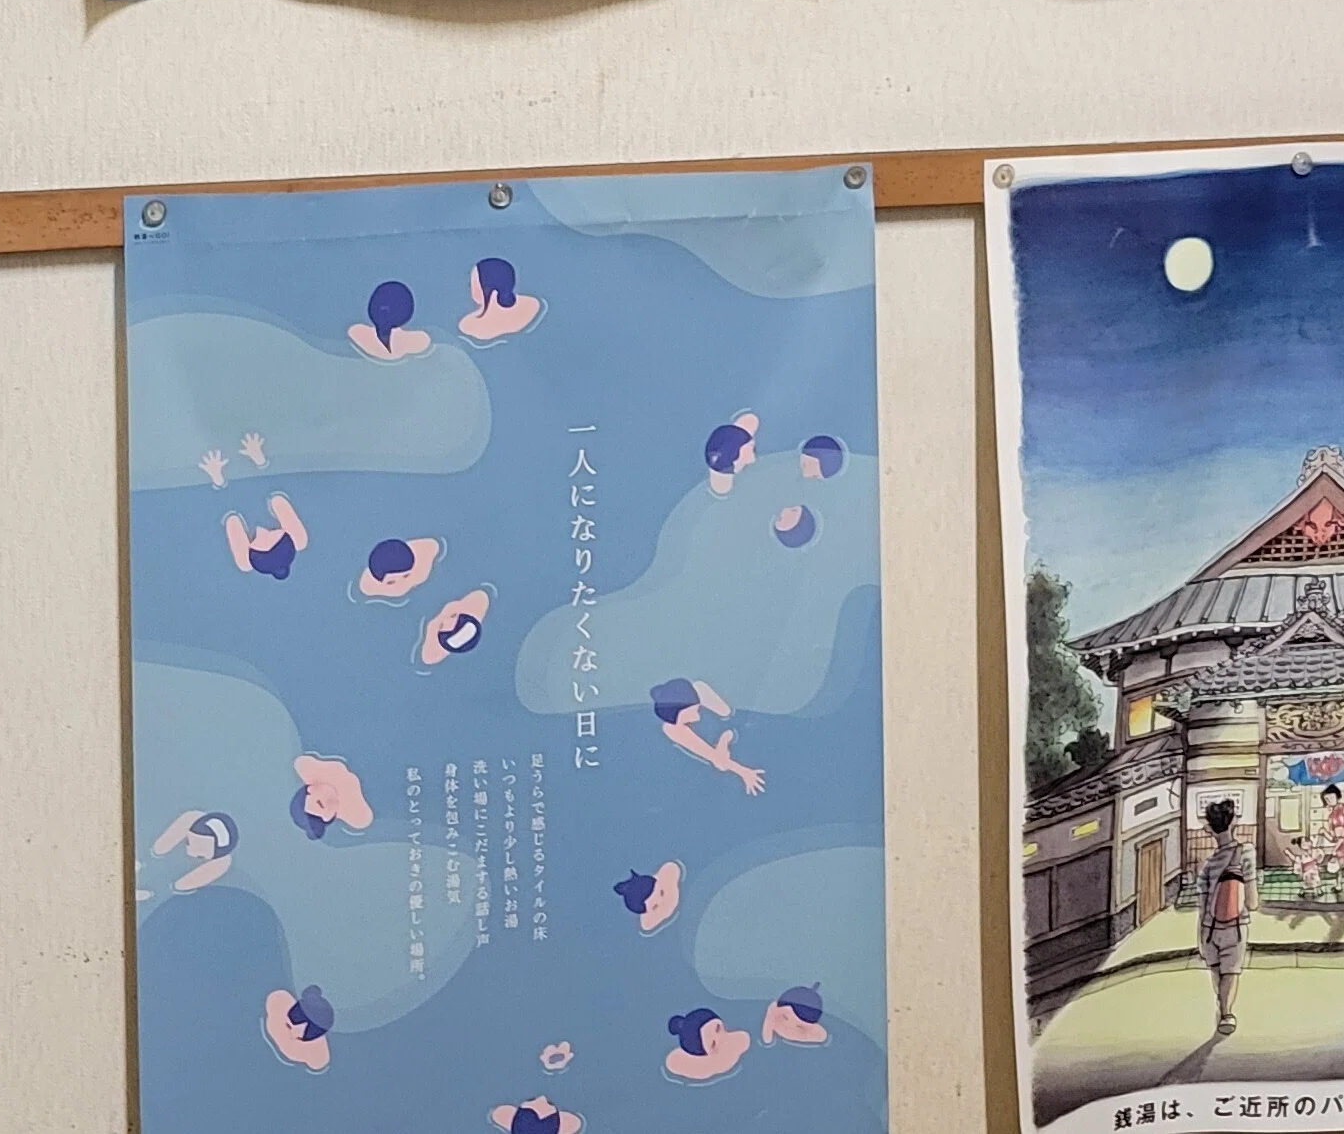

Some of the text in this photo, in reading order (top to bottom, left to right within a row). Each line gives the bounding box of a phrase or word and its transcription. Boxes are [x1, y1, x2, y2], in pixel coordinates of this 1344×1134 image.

[566, 423, 600, 770] 一人になりたくない日に
[406, 766, 426, 982] 私のとっておきの優しい場所。
[444, 762, 462, 904] 身体を包みこむ湯気
[472, 759, 491, 949] 洗い場にこだまする話し声
[501, 758, 519, 930] いつもより少し熱いお湯
[530, 752, 549, 942] 足うらで感じるタイルの床
